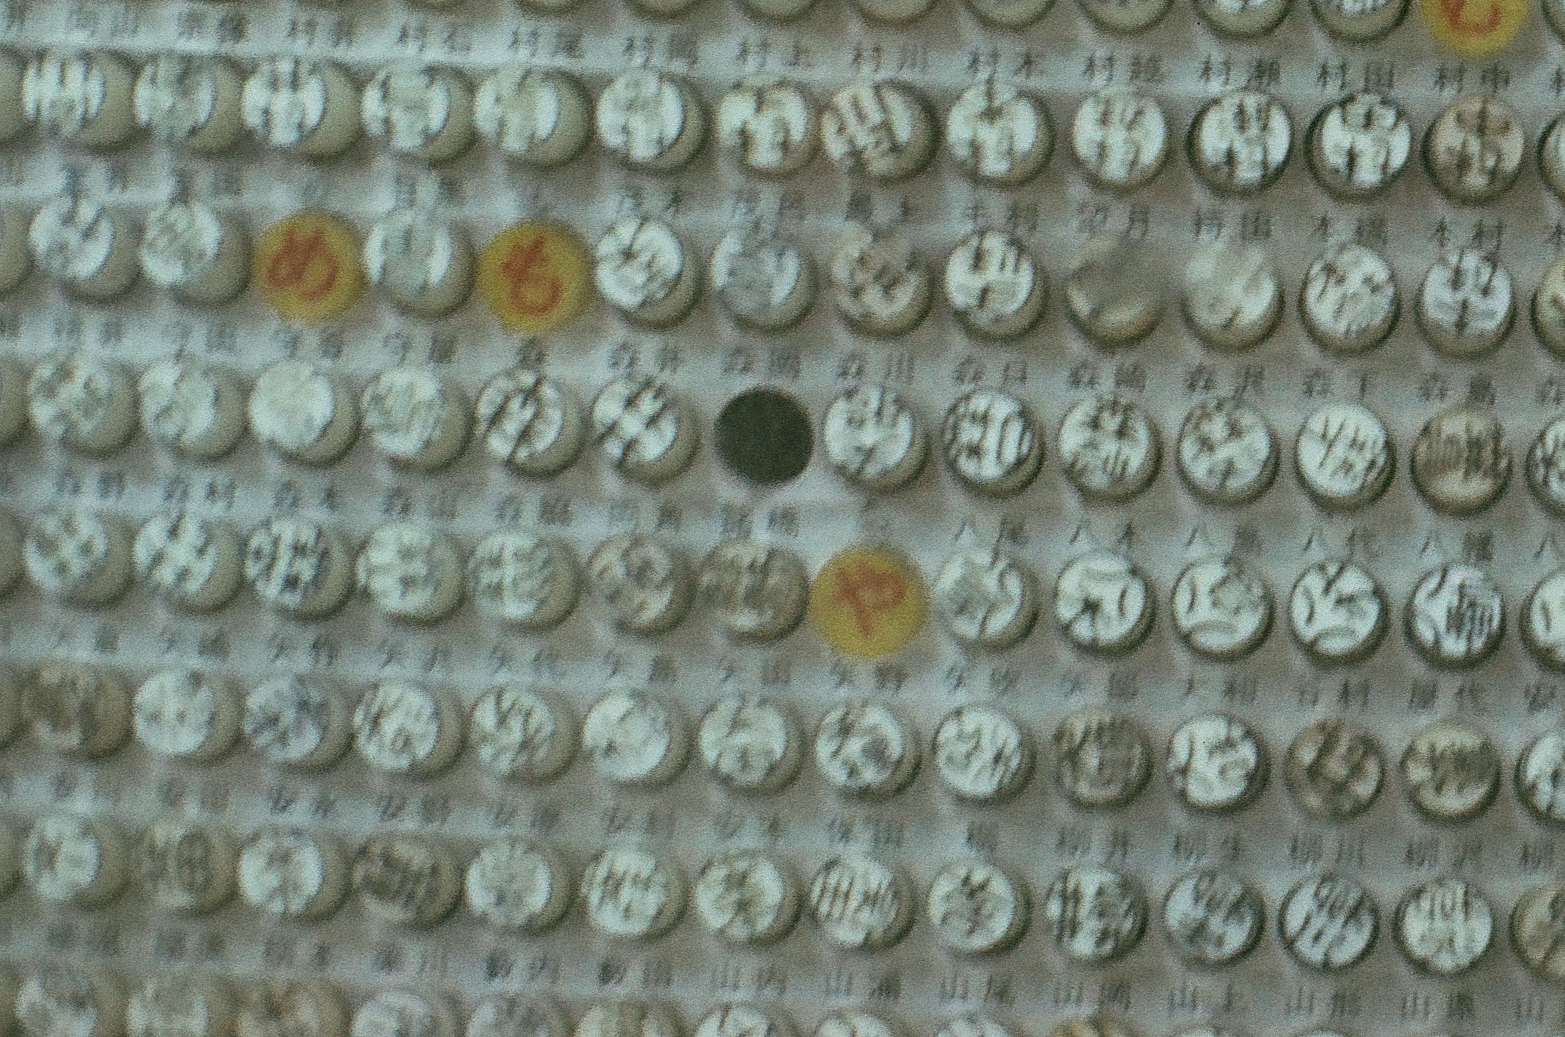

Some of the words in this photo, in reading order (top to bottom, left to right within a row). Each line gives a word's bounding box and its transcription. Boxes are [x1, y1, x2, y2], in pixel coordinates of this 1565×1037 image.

[735, 36, 812, 68] 村上
[967, 47, 1047, 78] 村木
[1316, 60, 1393, 91] 村田
[1426, 216, 1502, 247] 本村
[267, 225, 339, 300] め
[501, 235, 562, 316] も
[834, 563, 908, 639] や
